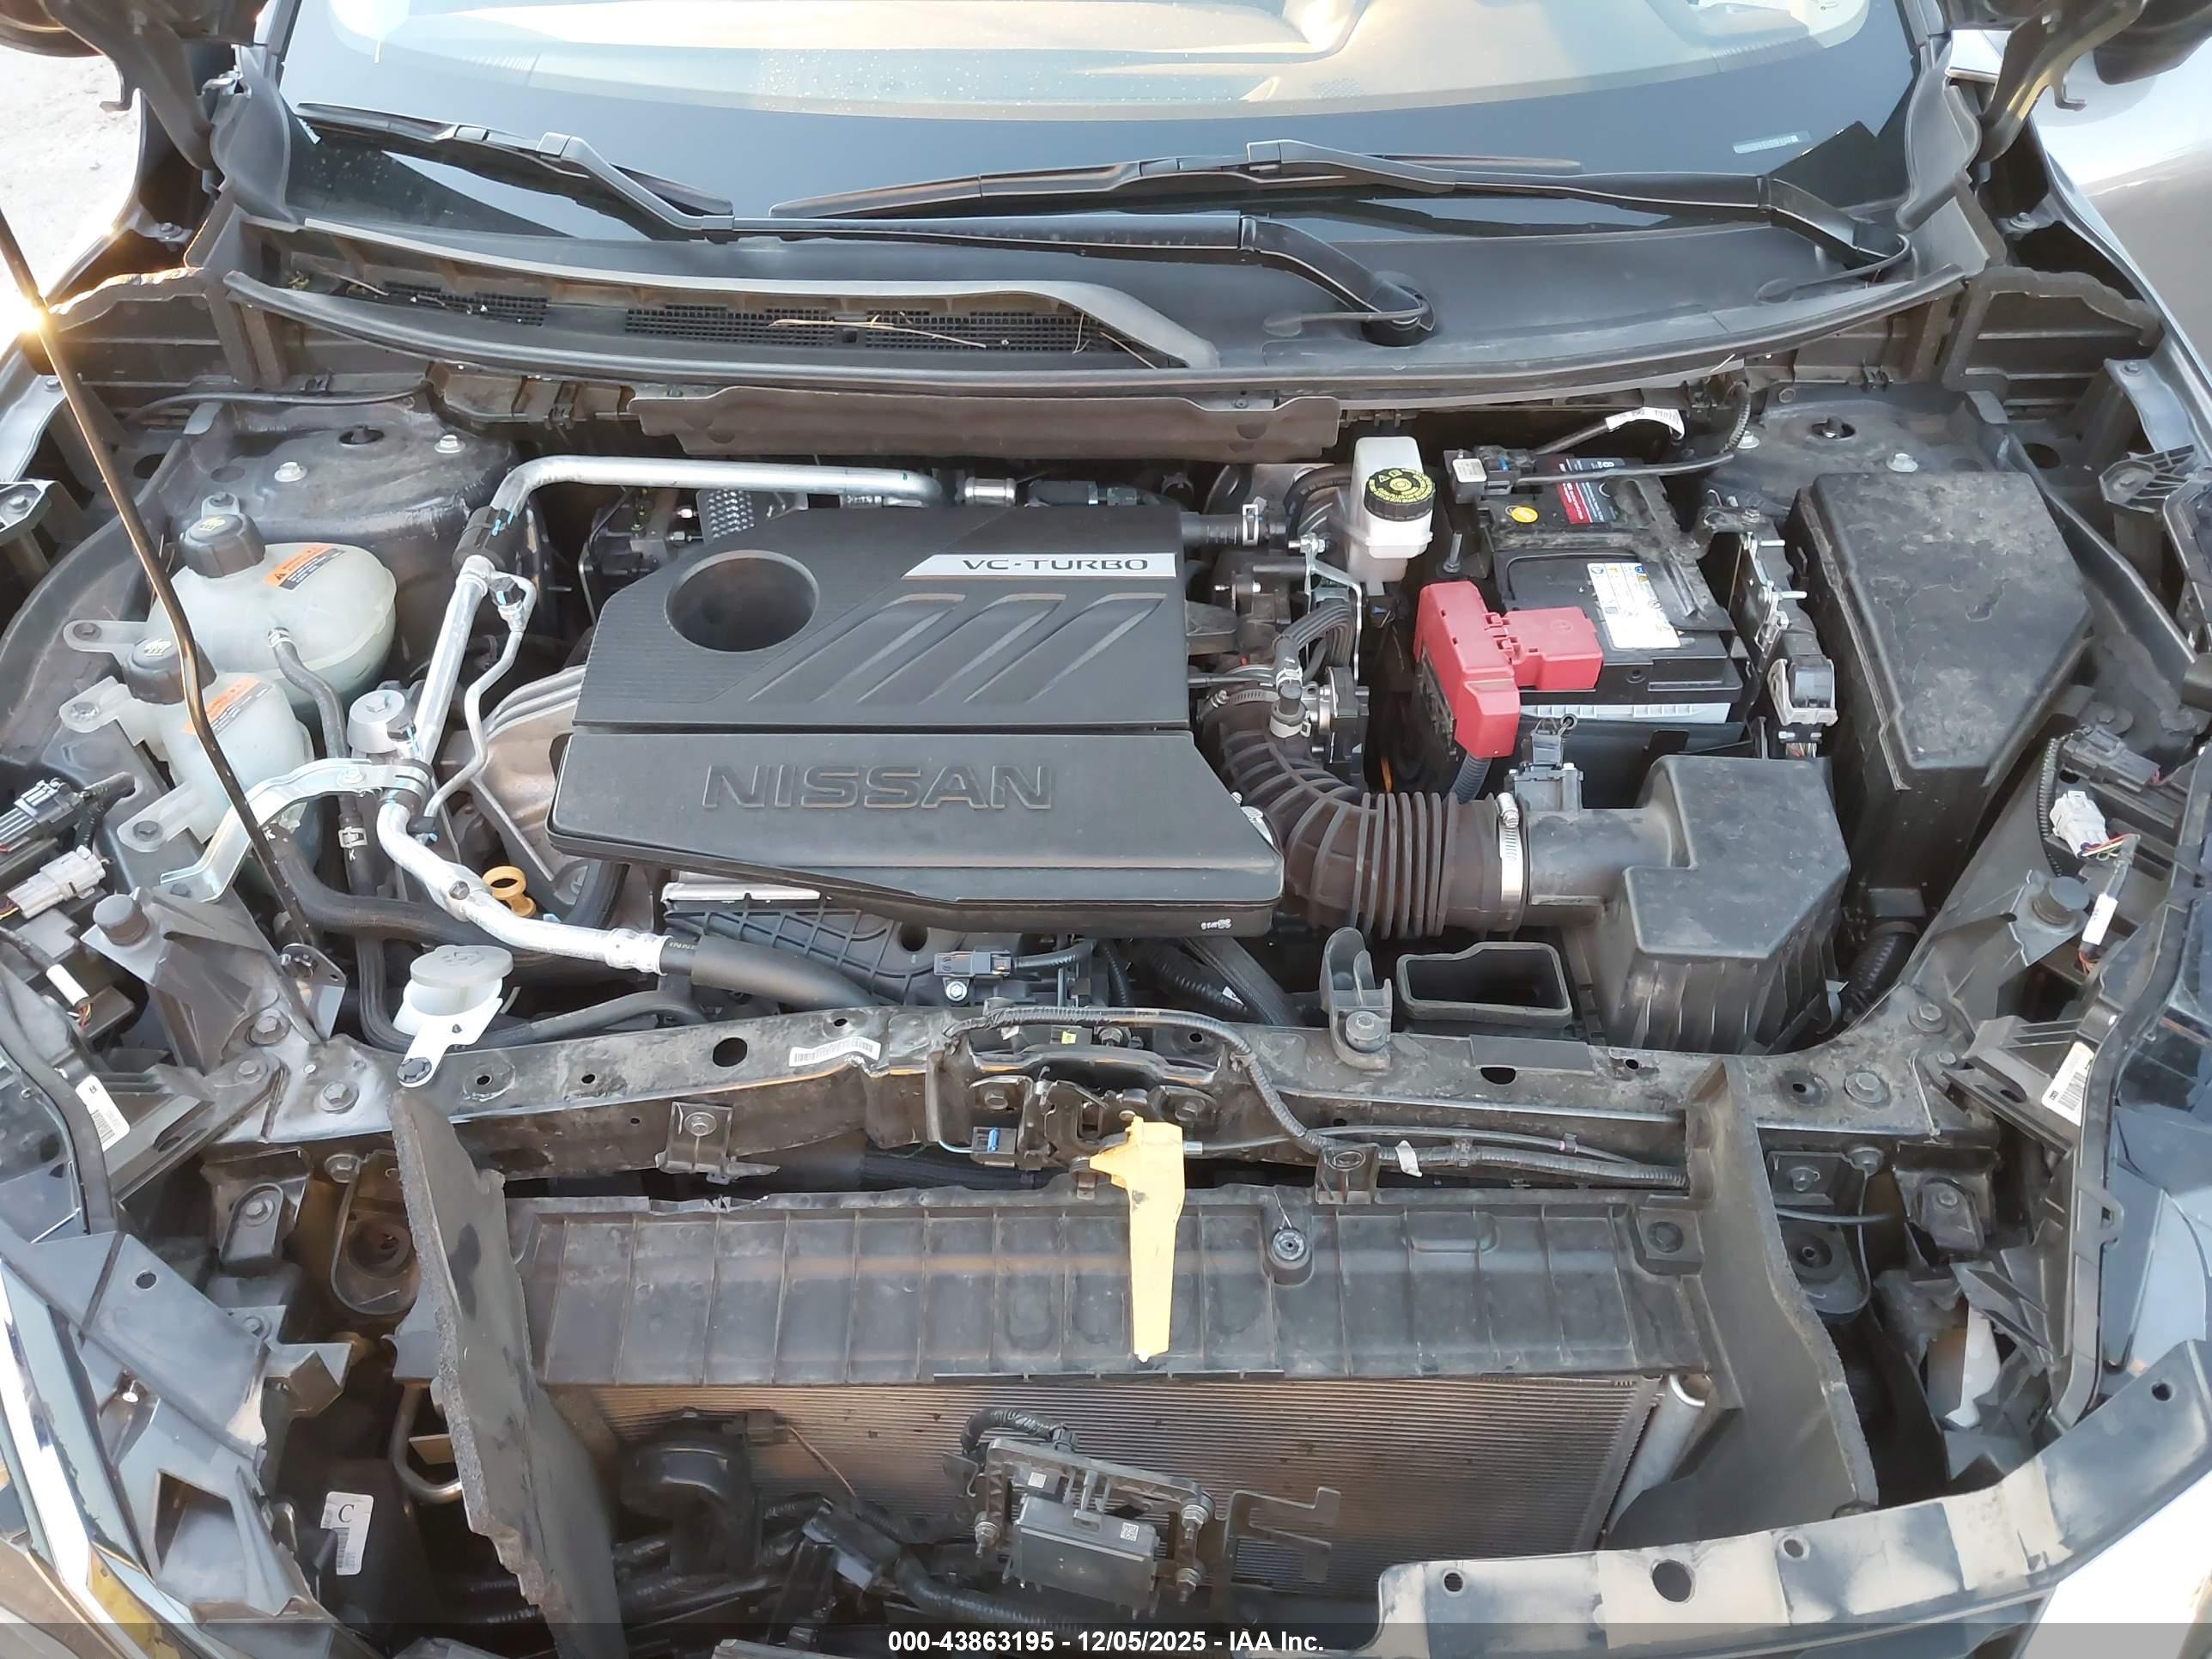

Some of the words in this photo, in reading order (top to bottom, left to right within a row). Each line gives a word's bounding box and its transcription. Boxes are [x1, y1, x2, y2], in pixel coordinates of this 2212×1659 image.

[962, 559, 1148, 570] VC-TURBO
[701, 764, 1053, 810] NISSAN
[349, 849, 356, 861] K
[338, 1504, 355, 1523] C
